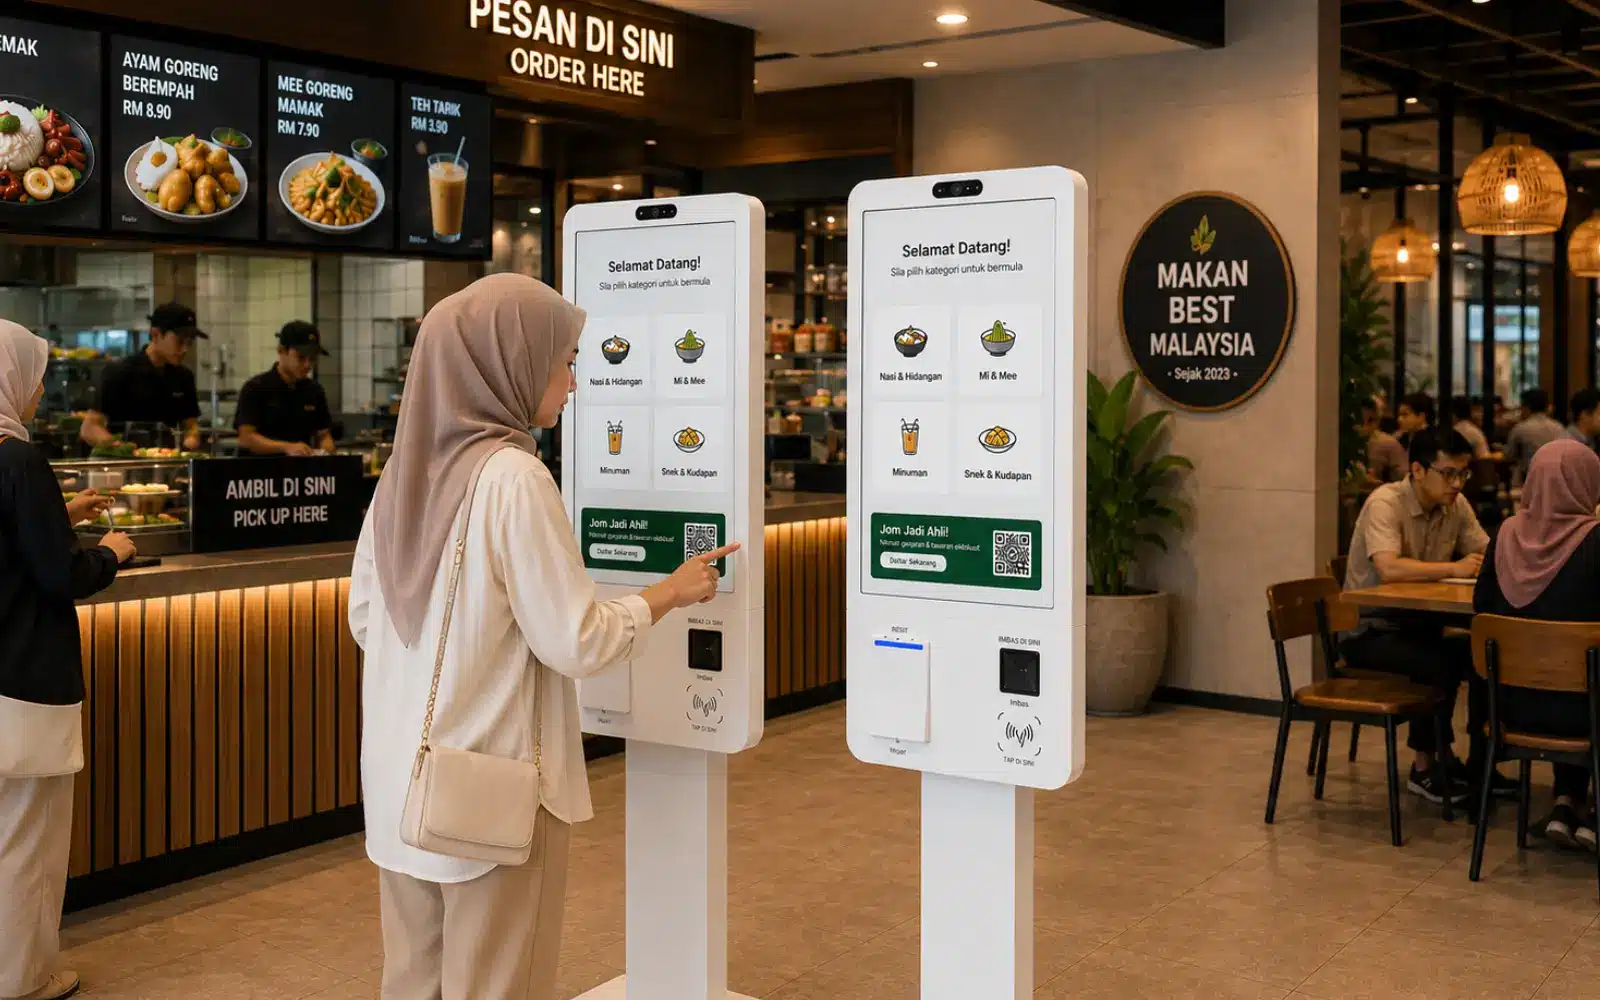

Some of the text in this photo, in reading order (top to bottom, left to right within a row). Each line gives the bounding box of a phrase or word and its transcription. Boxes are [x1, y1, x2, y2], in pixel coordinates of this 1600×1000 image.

[468, 0, 674, 68] PESAN DI SINI
[122, 51, 219, 82] AYAM GORENG
[510, 47, 645, 97] ORDER HERE
[123, 74, 194, 101] BEREMPAH
[278, 75, 353, 101] MEE GORENG
[123, 99, 172, 120] RM 8.90
[278, 97, 324, 118] MAMAK
[411, 96, 461, 117] TEH TARIK
[278, 119, 319, 138] RM 7.90
[411, 116, 448, 135] RM 3.90
[902, 238, 1011, 258] Selamat Datang!
[608, 256, 701, 273] Selamat Datang!
[925, 264, 959, 277] kategori
[961, 263, 985, 274] untuk
[987, 261, 1023, 273] bermula
[628, 279, 657, 291] kategori
[658, 278, 680, 288] untuk
[681, 276, 711, 287] bermula
[1157, 260, 1248, 289] MAKAN
[1169, 295, 1235, 324] BEST
[1150, 332, 1255, 356] MALAYSIA
[590, 377, 643, 387] Nasi & Hidangan
[674, 377, 706, 385] Mi & Mee
[879, 372, 942, 383] Nasi & Hidangan
[979, 371, 1017, 381] Mi & Mee
[1174, 367, 1230, 382] Sejak 2023
[600, 467, 630, 475] Minuman
[661, 468, 718, 478] Snek & Kudapan
[892, 468, 928, 478] Minuman
[964, 469, 1032, 482] Snek & Kudapan
[226, 476, 336, 500] AMBIL DI SINI
[234, 505, 328, 528] PICK UP HERE
[589, 518, 608, 528] Jom
[609, 518, 627, 529] Jadi
[880, 524, 949, 537] Jom Jadi Ahli!
